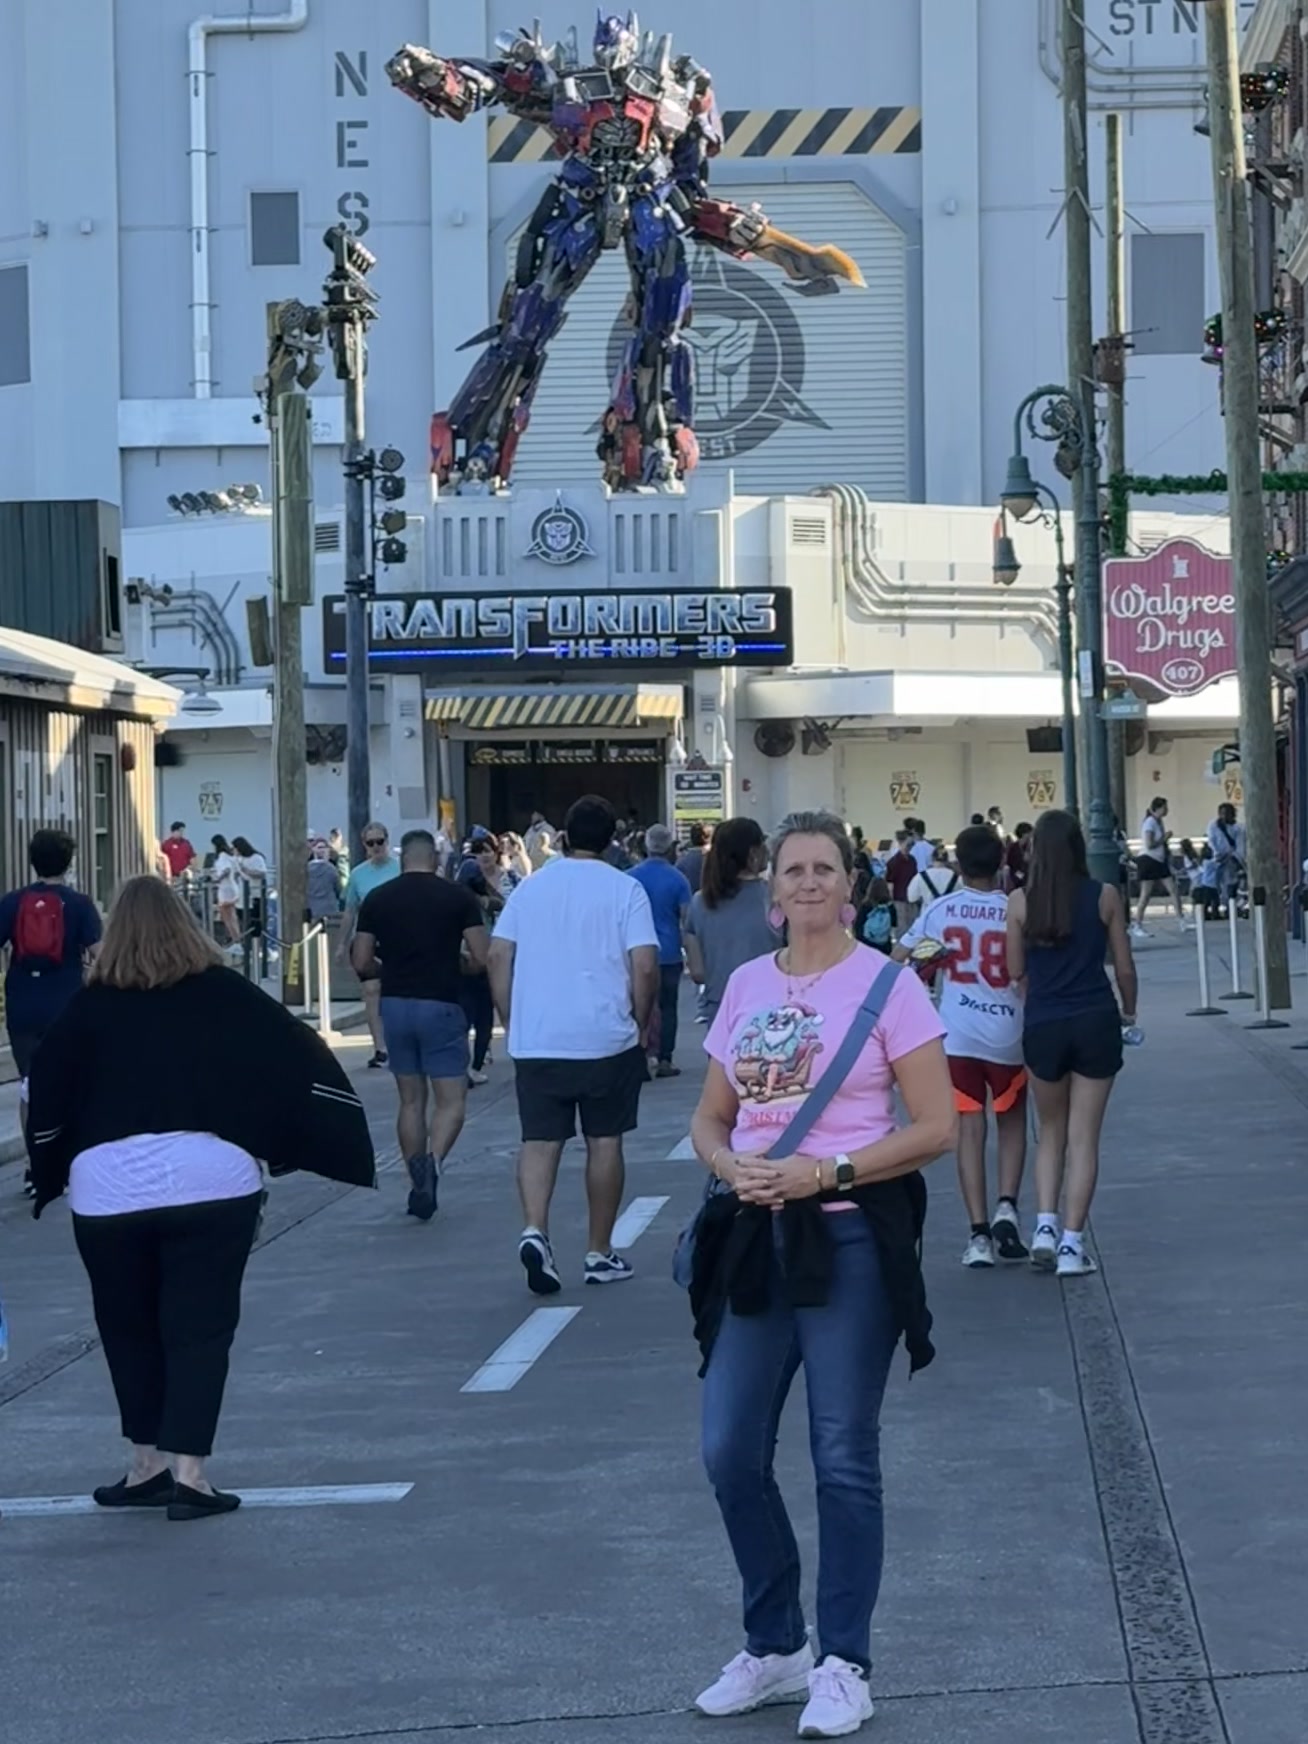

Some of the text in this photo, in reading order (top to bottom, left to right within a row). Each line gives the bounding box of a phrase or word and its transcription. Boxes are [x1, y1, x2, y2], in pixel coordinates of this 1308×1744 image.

[550, 638, 604, 659] THE
[1135, 617, 1229, 658] Drugs
[943, 926, 1010, 989] 28
